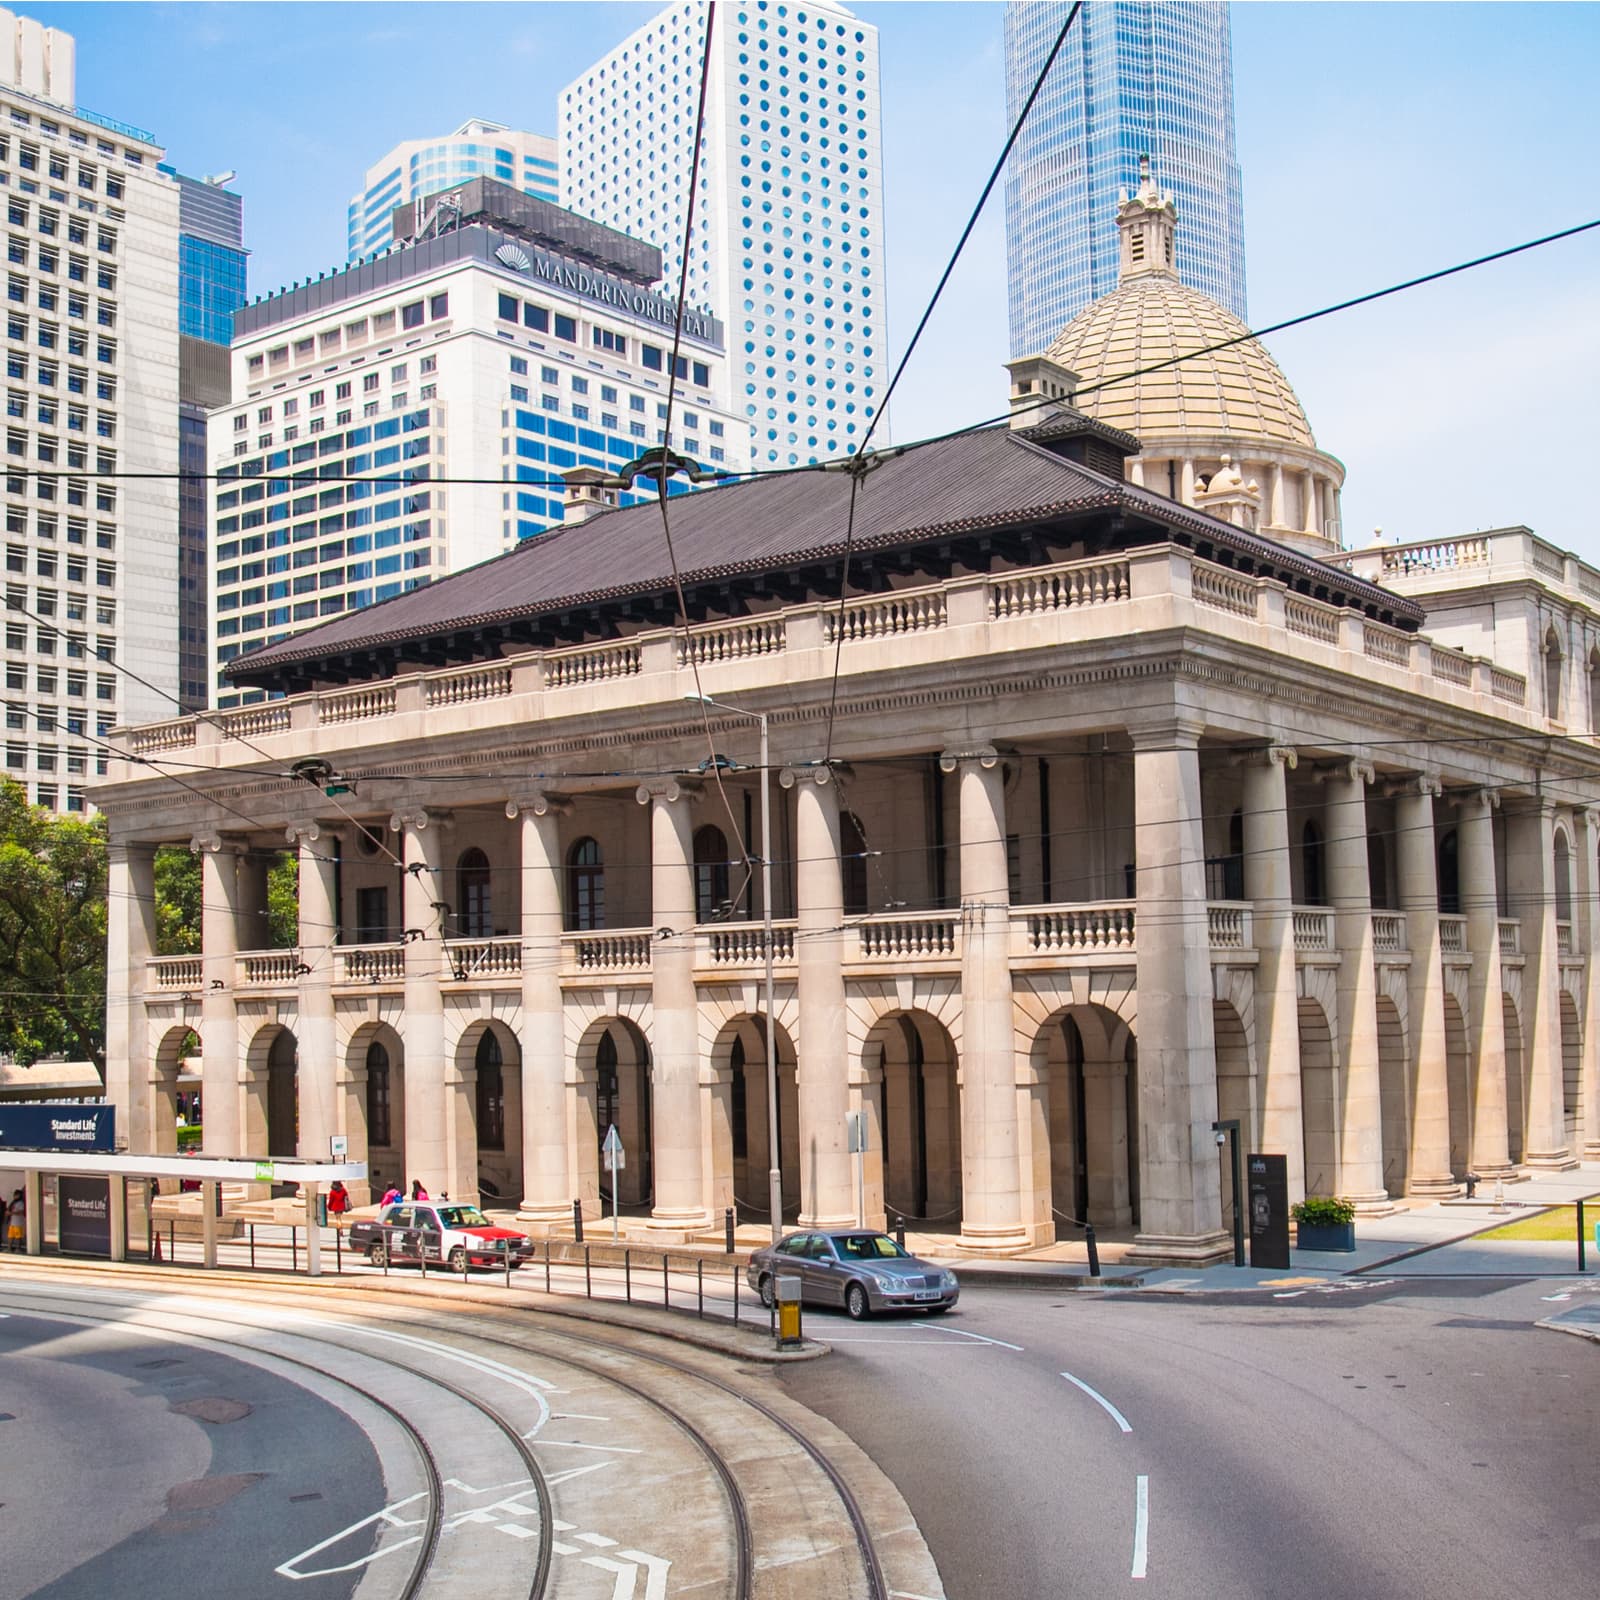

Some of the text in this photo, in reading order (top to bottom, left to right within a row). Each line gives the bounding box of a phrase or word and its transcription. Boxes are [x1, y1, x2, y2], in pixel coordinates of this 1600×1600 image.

[535, 258, 712, 339] MANDARIN ORIENTAL
[51, 1119, 96, 1130] Standard Life
[56, 1130, 95, 1140] Investments
[68, 1198, 106, 1210] Standard Life
